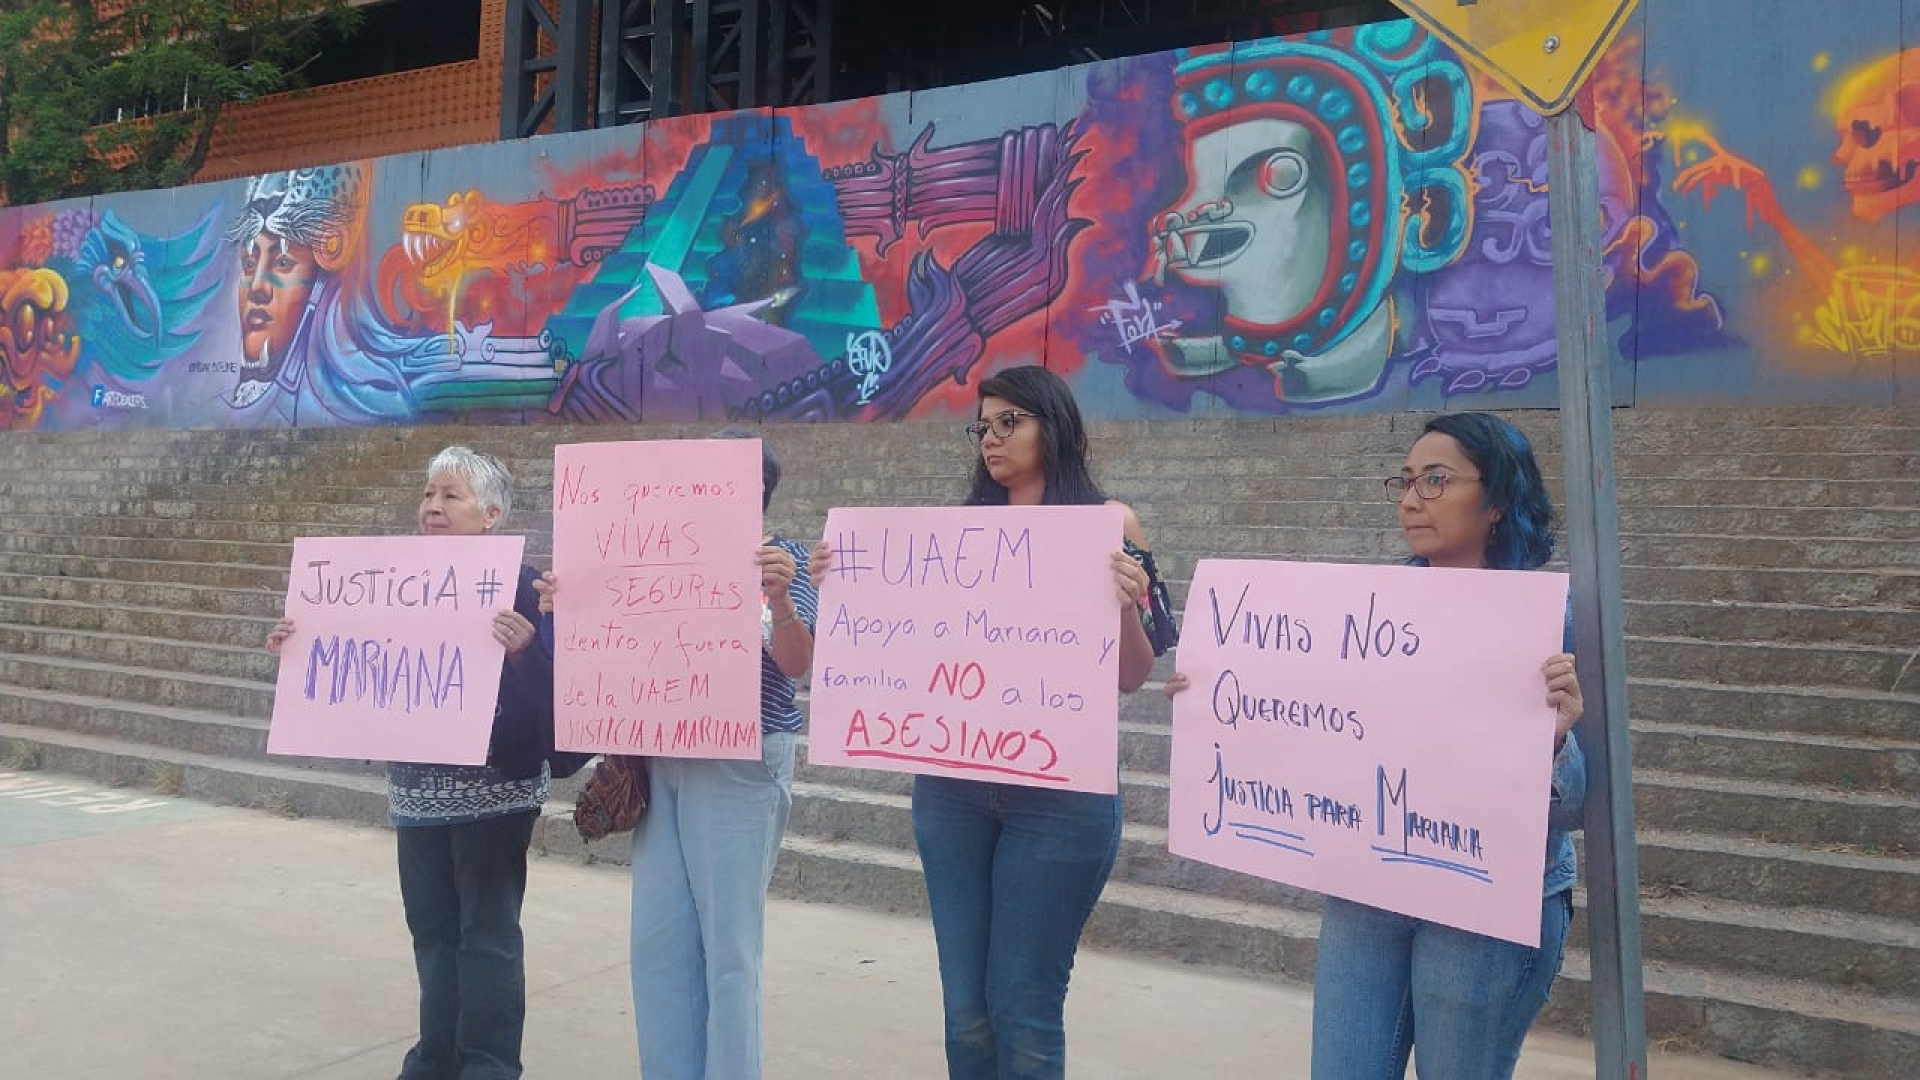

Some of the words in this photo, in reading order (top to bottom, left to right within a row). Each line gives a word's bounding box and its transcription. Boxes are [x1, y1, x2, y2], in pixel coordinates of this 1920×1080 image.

[560, 464, 600, 510] Nos
[624, 480, 736, 515] queremos
[830, 527, 1034, 589] #UAEM
[606, 574, 745, 611] SEGURAS
[564, 620, 640, 652] dentro
[649, 640, 662, 668] y
[676, 622, 750, 668] fuera
[829, 603, 916, 648] Apoya
[933, 621, 950, 638] a
[965, 609, 1080, 646] Mariana
[1098, 636, 1116, 665] y
[1208, 582, 1313, 654] VIVAS
[1340, 592, 1421, 660] NOS
[821, 667, 907, 691] familia
[927, 661, 986, 701] NO
[1001, 687, 1023, 705] a
[1040, 677, 1084, 712] los
[671, 716, 758, 750] MARIANA
[844, 708, 1058, 772] ASESINOS
